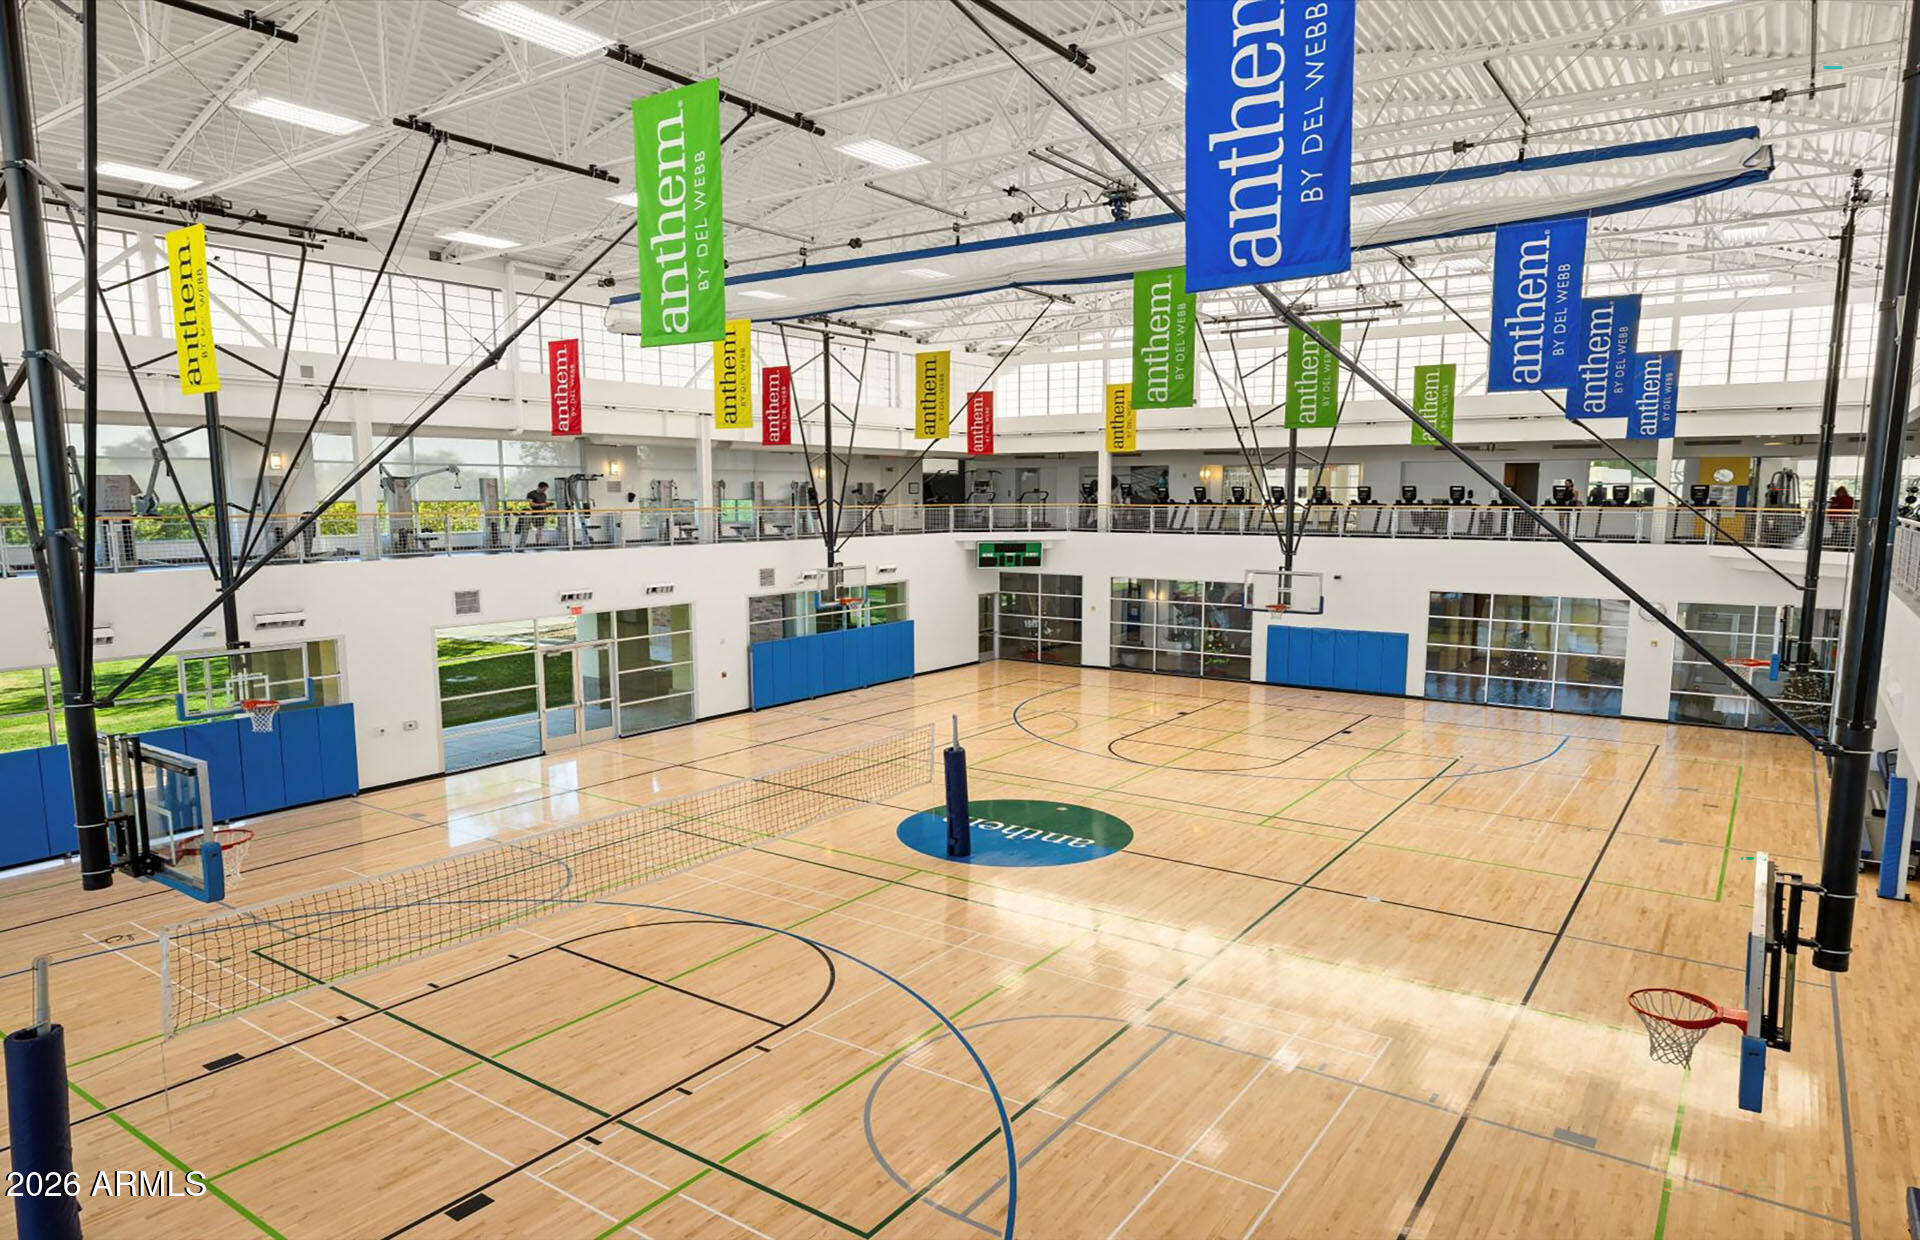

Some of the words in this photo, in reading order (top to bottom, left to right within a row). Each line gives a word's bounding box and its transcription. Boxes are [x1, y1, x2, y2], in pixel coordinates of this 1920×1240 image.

[1305, 2, 1328, 91] WEBB
[1302, 97, 1324, 155] DEL
[694, 150, 706, 211] WEBB
[1300, 168, 1324, 203] BY
[694, 217, 709, 258] DEL
[698, 268, 710, 291] BY
[1556, 263, 1571, 303] WEBB
[1176, 303, 1187, 333] WEBB
[1553, 308, 1568, 333] DEL
[1175, 340, 1186, 362] DEL
[1552, 338, 1566, 356] BY
[1617, 326, 1629, 356] WEBB
[1174, 366, 1185, 381] BY
[1614, 359, 1626, 379] DEL
[1322, 376, 1332, 393] DEL
[1613, 382, 1624, 394] BY
[1664, 372, 1674, 394] WEBB
[1322, 394, 1331, 407] BY
[1663, 395, 1672, 410] DEL
[1662, 410, 1671, 422] BY
[943, 816, 1096, 848] anthe
